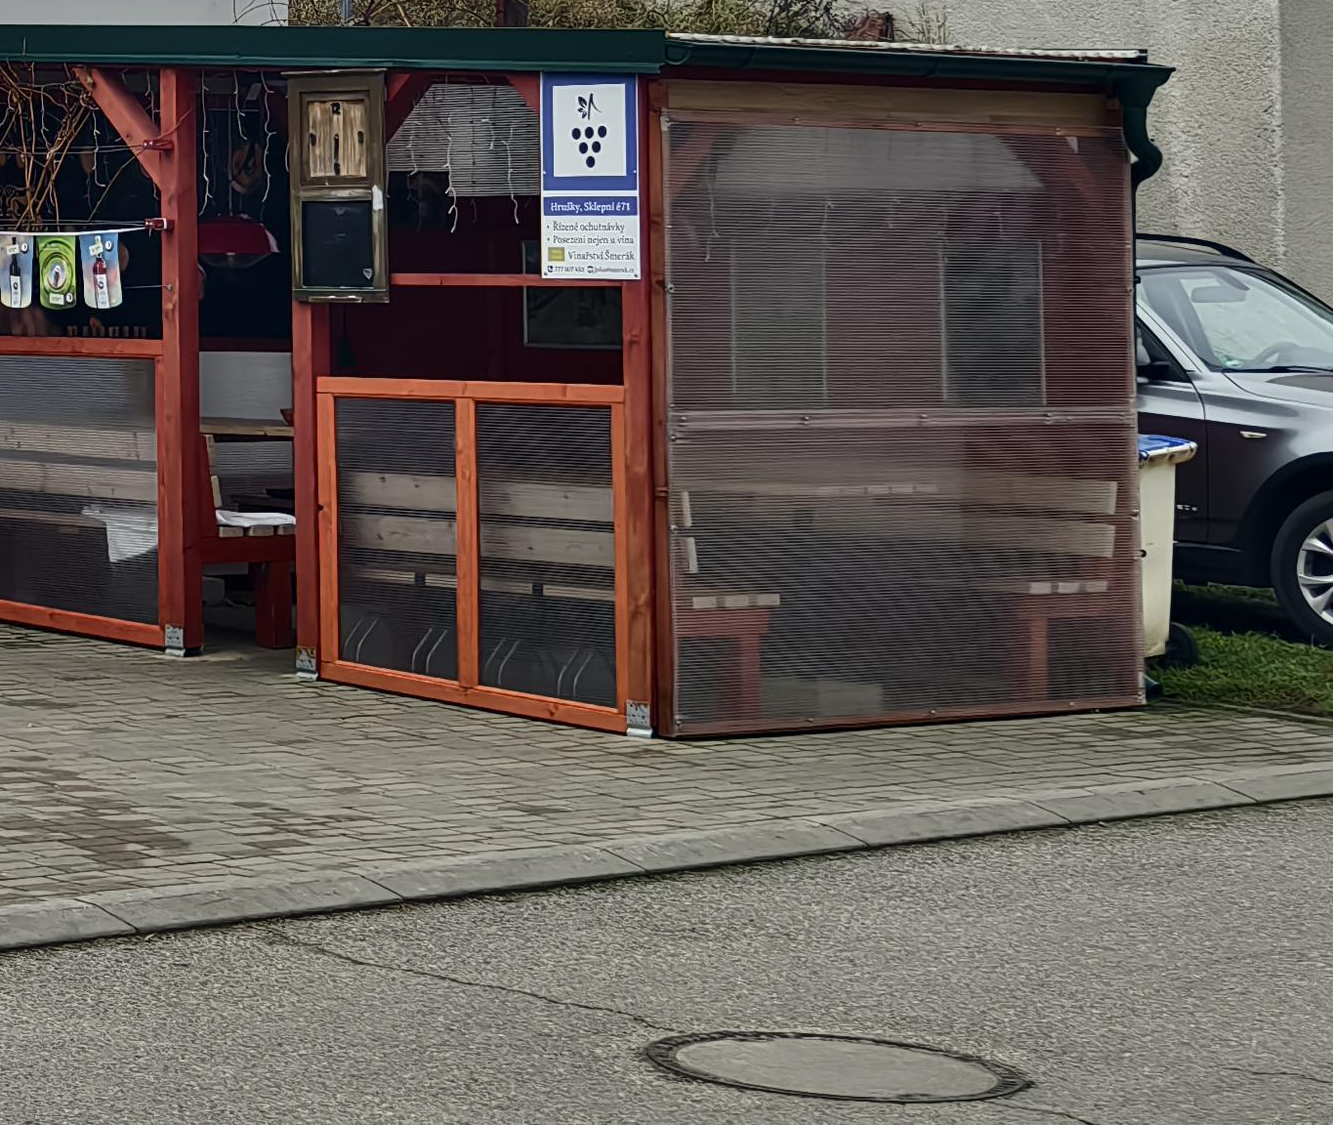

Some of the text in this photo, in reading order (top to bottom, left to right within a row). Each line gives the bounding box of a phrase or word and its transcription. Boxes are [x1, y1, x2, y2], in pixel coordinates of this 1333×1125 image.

[550, 201, 583, 214] Hrušky,
[583, 201, 615, 214] Sklepní
[579, 222, 625, 233] ochutnávky
[587, 235, 609, 246] nejen
[568, 251, 604, 260] Vinařství
[604, 249, 635, 260] Šmerák
